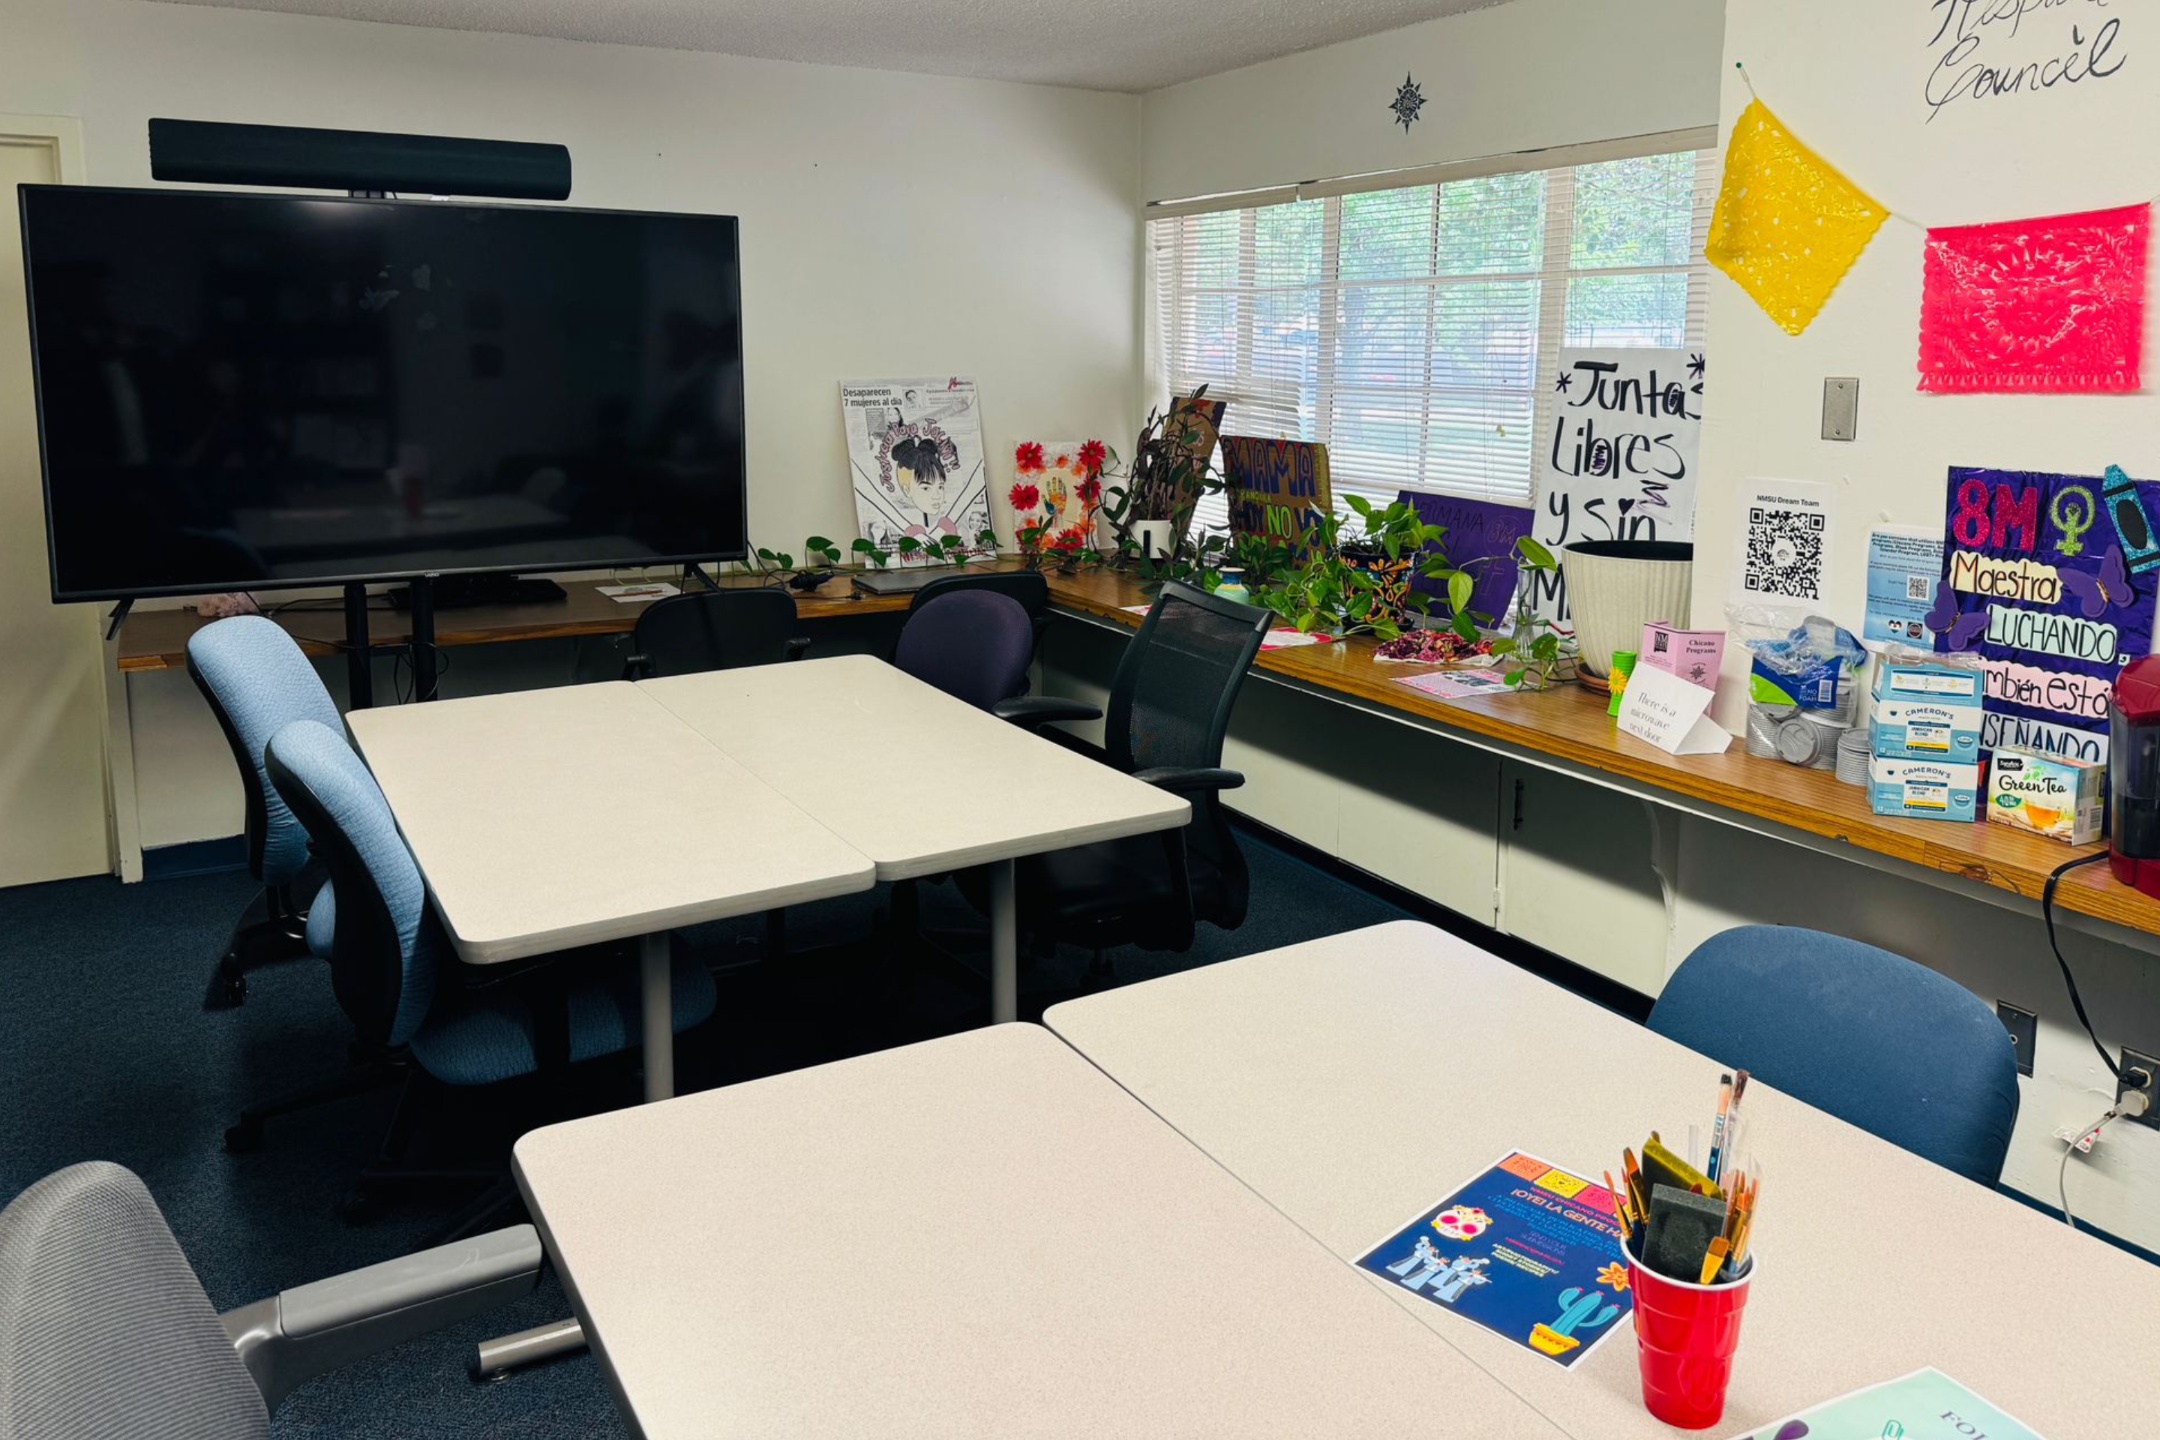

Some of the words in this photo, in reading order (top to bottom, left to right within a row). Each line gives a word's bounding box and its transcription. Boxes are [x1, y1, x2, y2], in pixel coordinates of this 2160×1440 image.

[842, 388, 891, 398] Desaparecen
[844, 399, 849, 407] 7
[850, 399, 881, 407] mujeres
[882, 397, 889, 406] al
[1551, 416, 1686, 480] Libres
[1757, 495, 1777, 503] NMSU
[1778, 497, 1799, 505] Dream
[1266, 504, 1293, 540] NO
[1953, 478, 2038, 552] 8M
[1953, 551, 2058, 601] Maestra
[1686, 647, 1717, 655] Programs
[1983, 667, 2042, 704] mbién
[1638, 692, 1661, 709] There
[1905, 707, 1954, 720] CAMERON'S
[1644, 727, 1661, 743] door
[1902, 767, 1951, 779] CAMERON'S
[1998, 774, 2045, 793] Green
[2042, 777, 2067, 795] Tea
[1545, 1202, 1562, 1214] LA
[1562, 1209, 1609, 1232] GENTE
